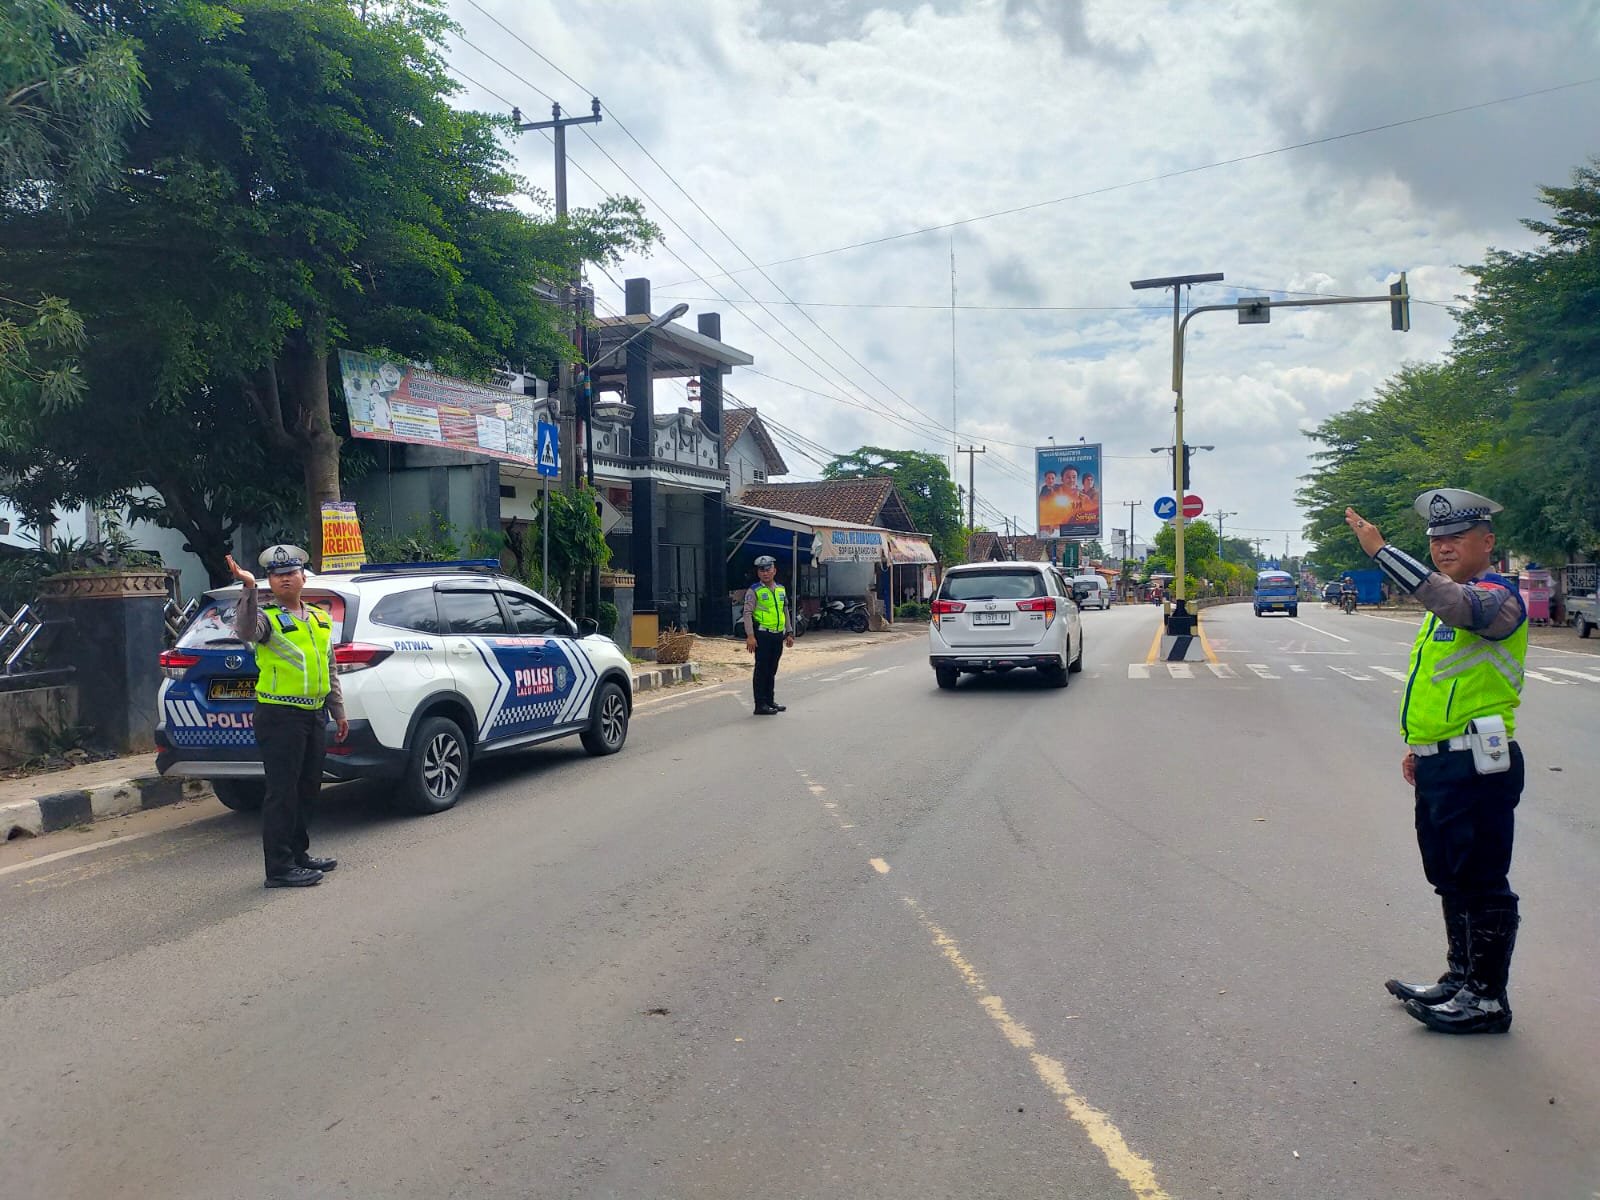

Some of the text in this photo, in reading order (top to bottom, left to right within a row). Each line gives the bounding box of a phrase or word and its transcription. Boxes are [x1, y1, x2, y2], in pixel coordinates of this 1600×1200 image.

[324, 537, 363, 554] KREATIF
[394, 641, 433, 651] PATWAL
[514, 667, 554, 688] POLISI
[516, 684, 554, 697] LALU LINTAS
